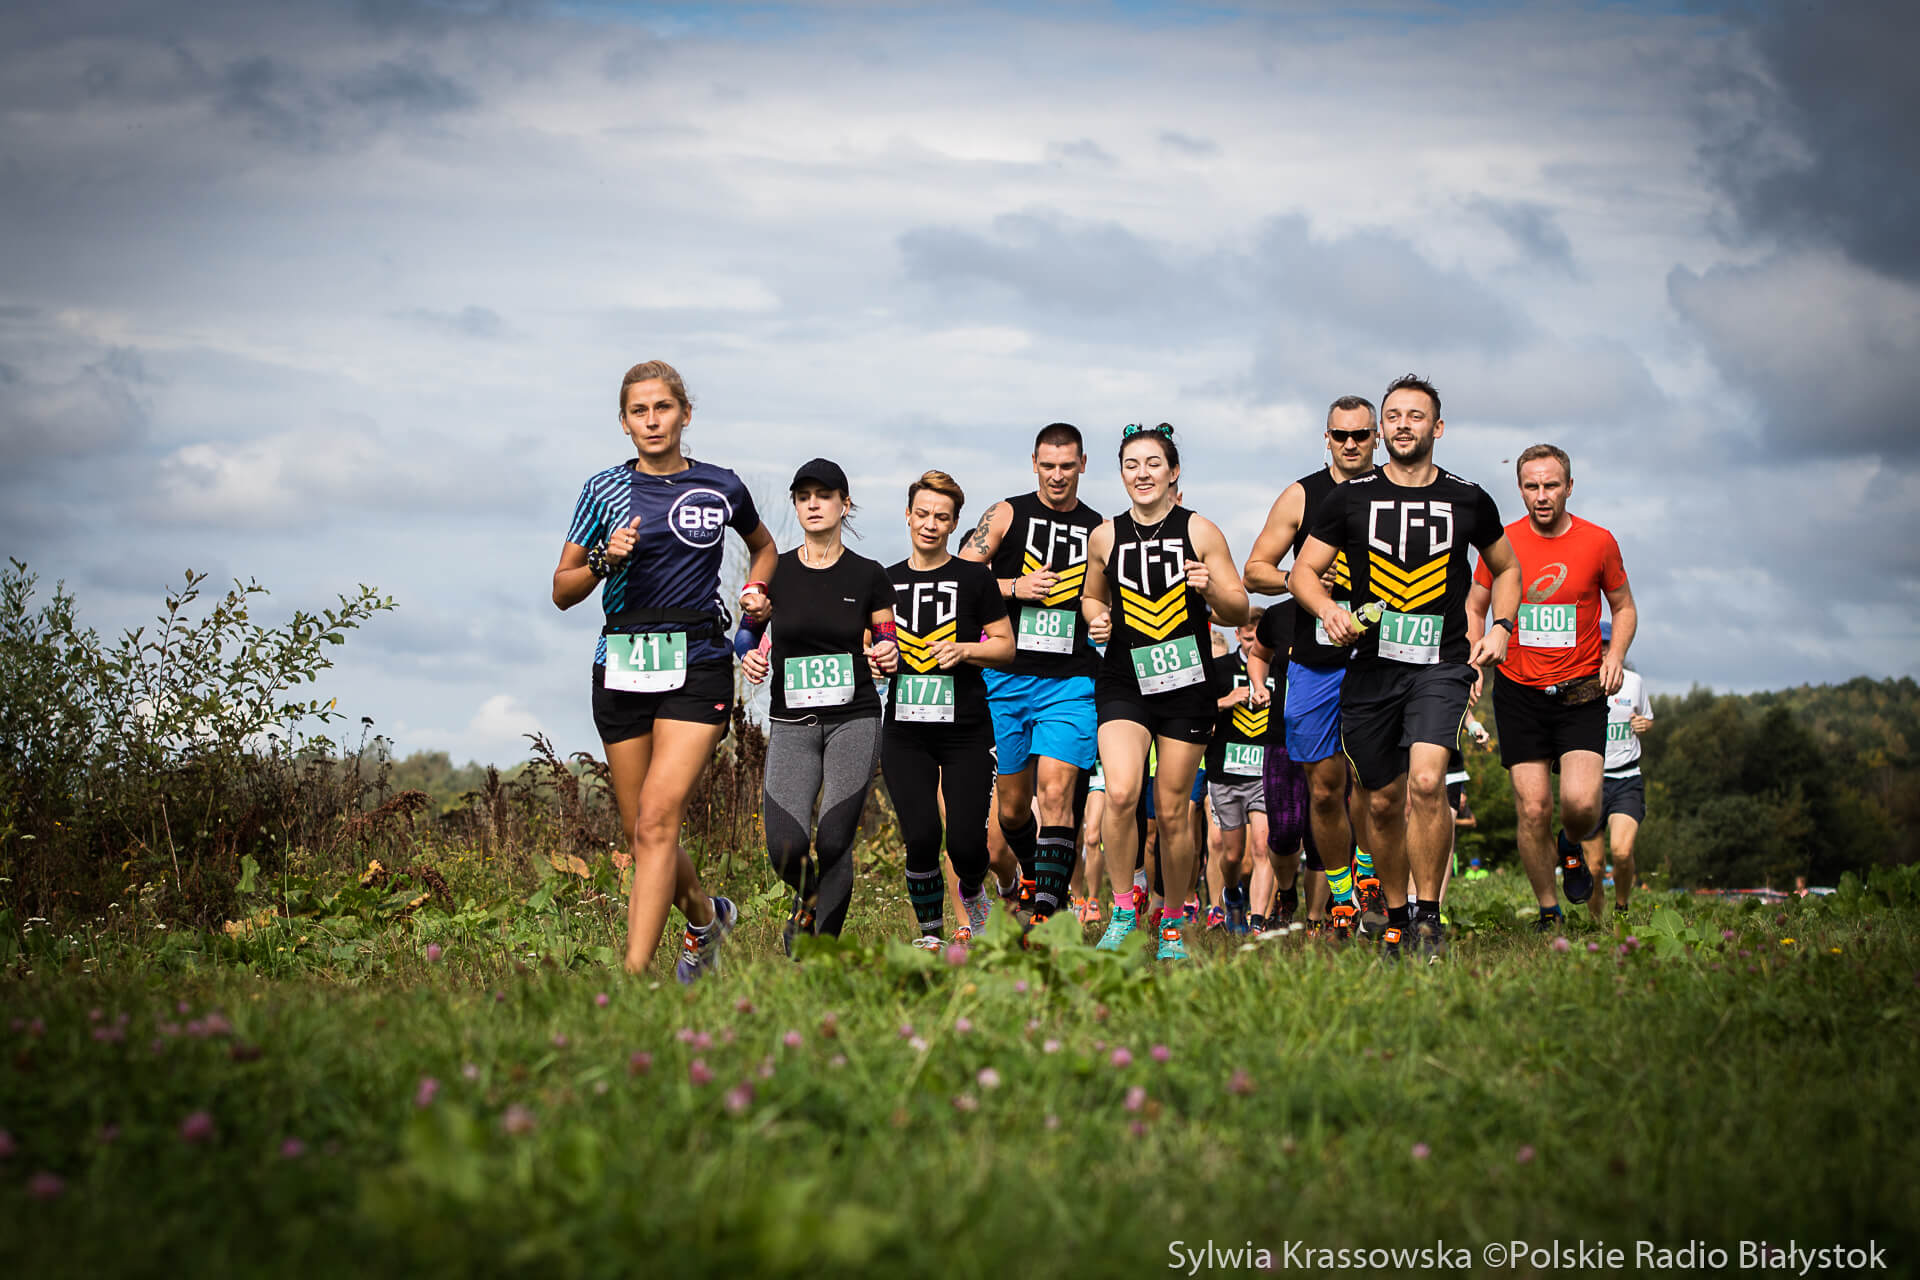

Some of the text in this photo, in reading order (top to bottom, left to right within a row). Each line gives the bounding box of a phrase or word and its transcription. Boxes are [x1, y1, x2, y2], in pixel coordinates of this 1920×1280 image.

[687, 530, 714, 538] TEAM
[1368, 500, 1454, 563] CFS
[1035, 610, 1061, 636] 88
[1395, 615, 1433, 645] 179
[1530, 606, 1566, 631] 160
[629, 636, 661, 670] 41
[1150, 643, 1181, 674] 83
[798, 657, 840, 689] 133
[905, 678, 942, 705] 177
[1235, 746, 1261, 766] 140
